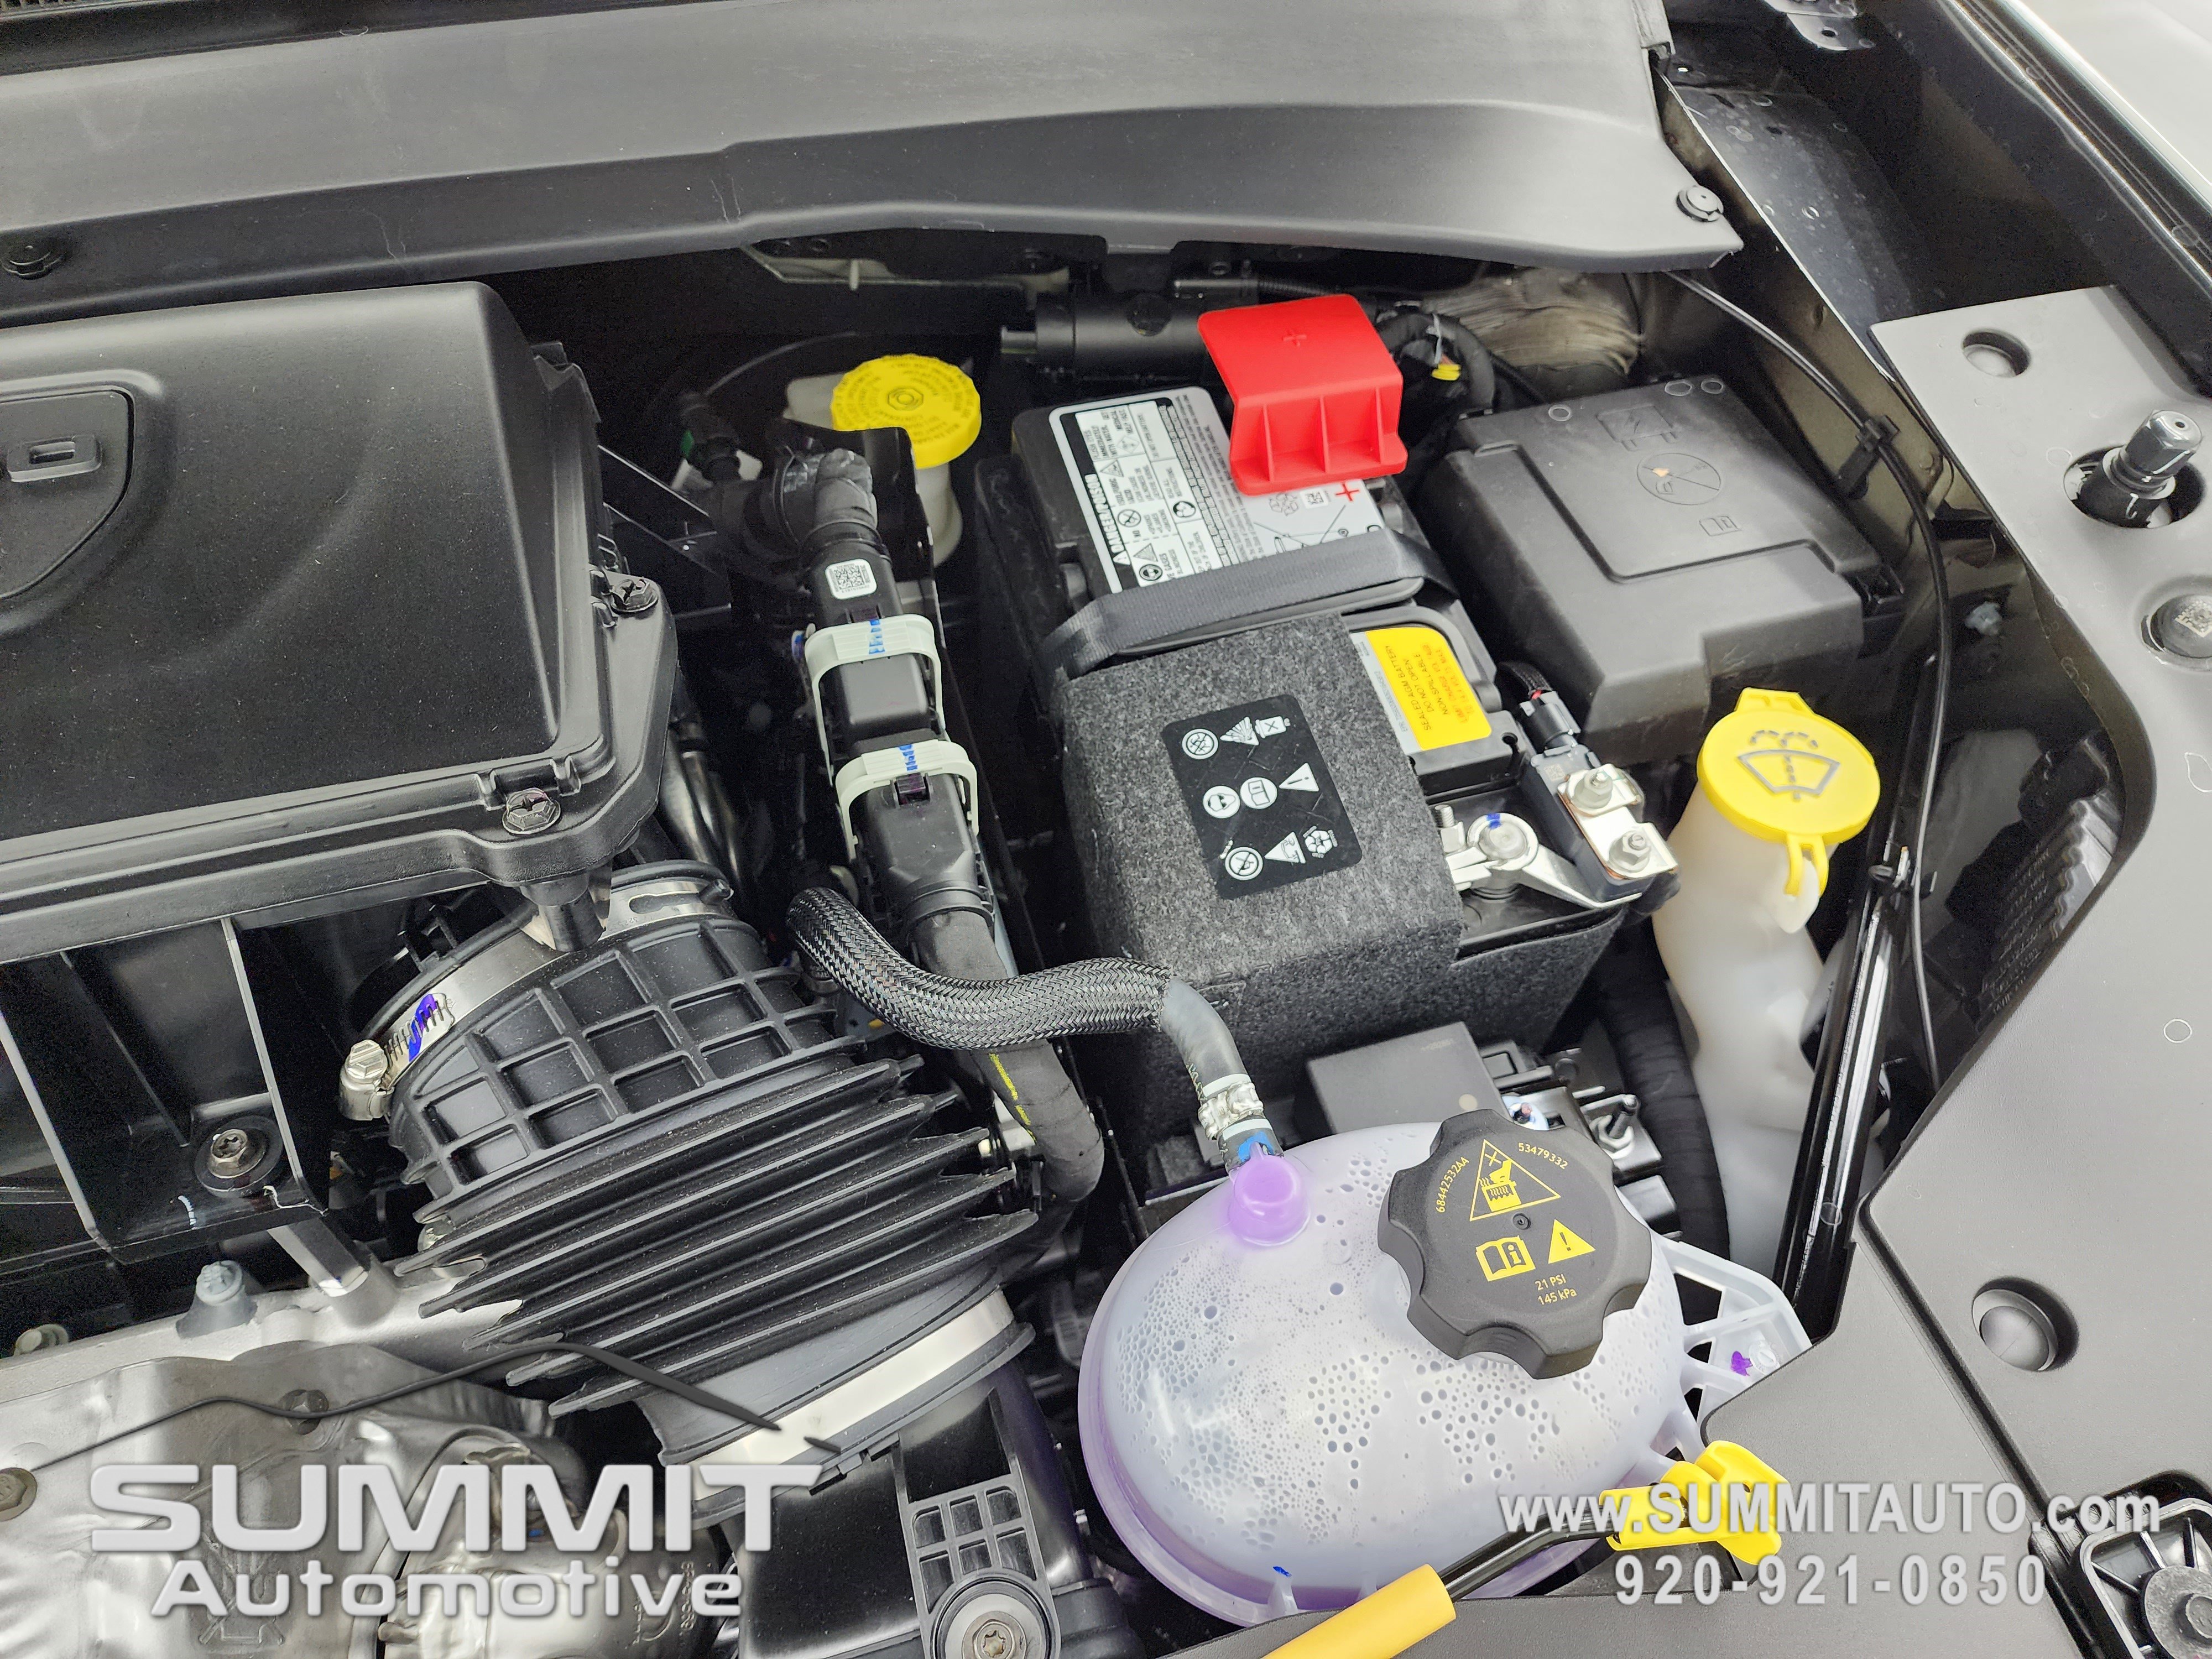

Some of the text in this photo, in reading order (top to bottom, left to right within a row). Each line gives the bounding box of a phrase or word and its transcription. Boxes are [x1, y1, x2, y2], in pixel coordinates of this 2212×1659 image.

[1083, 473, 1125, 552] DANGER/POISON
[1383, 645, 1406, 678] BATTERY
[1400, 680, 1415, 697] AGM
[1401, 659, 1434, 712] DO NOT OPEN
[1410, 699, 1432, 731] SEALED
[1518, 1142, 1569, 1170] 53479332
[1436, 1157, 1469, 1213] 68442532AA
[1536, 1274, 1566, 1291] 21 PSI
[1538, 1288, 1577, 1306] 145 kPa
